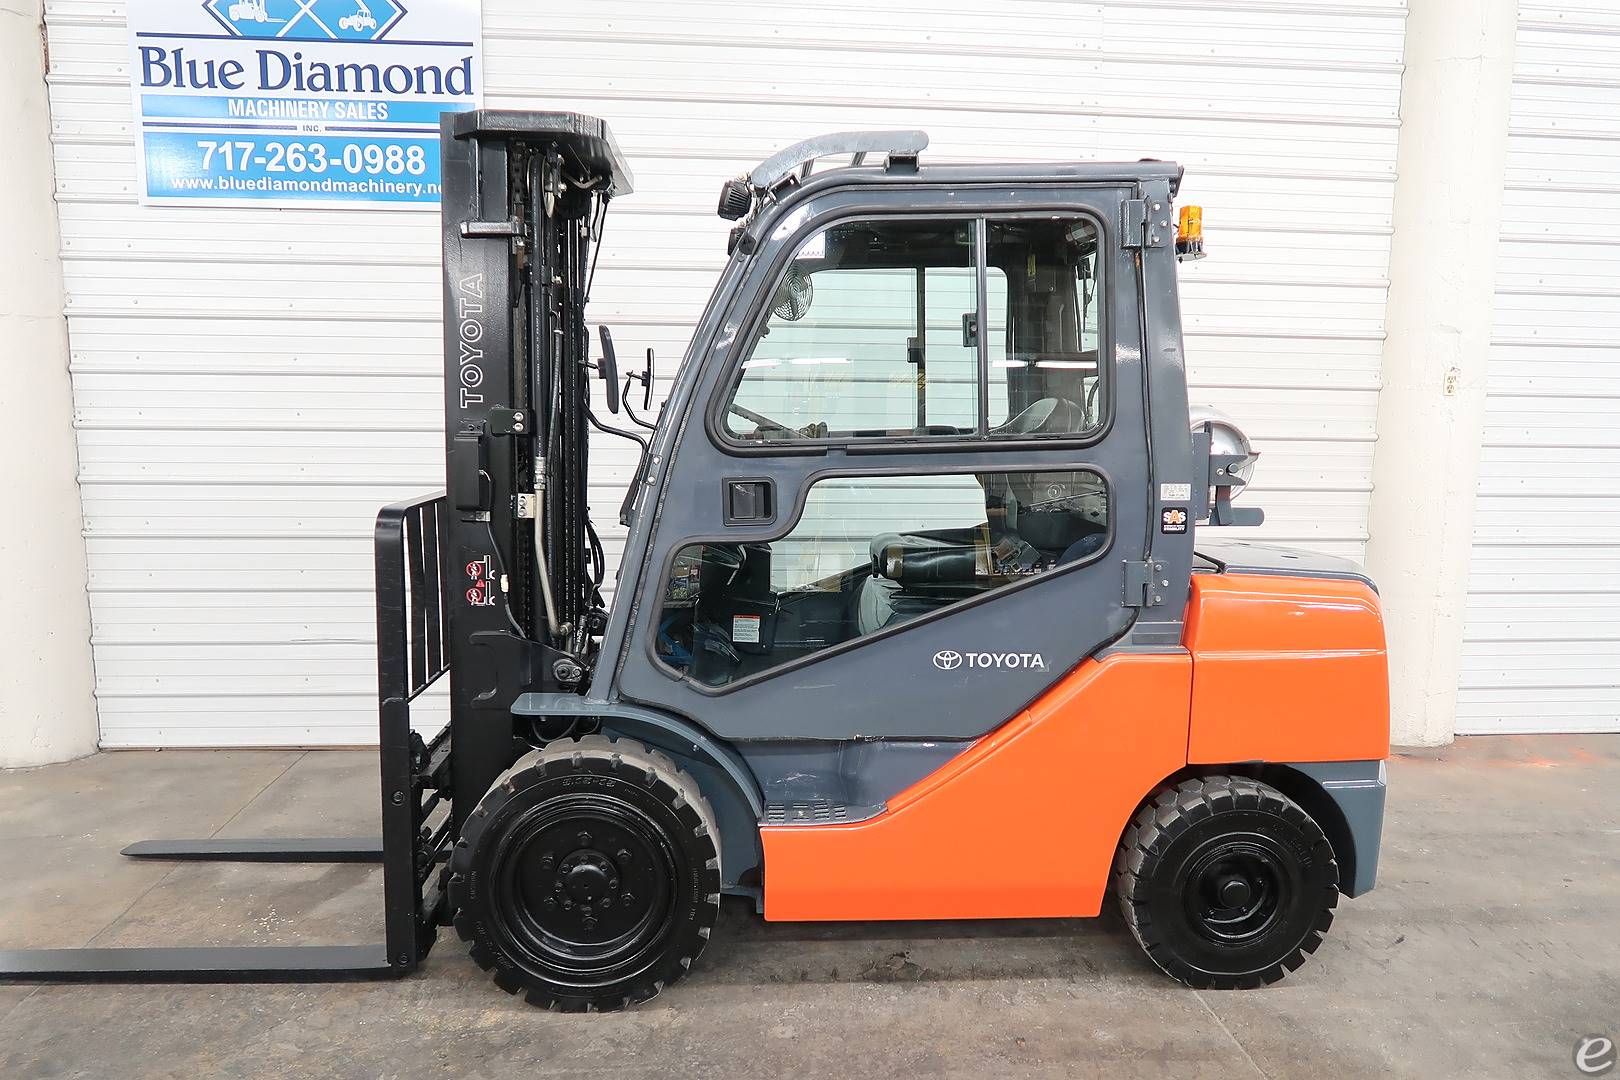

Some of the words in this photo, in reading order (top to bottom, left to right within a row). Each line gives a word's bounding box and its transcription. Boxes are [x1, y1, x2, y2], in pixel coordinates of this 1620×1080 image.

[138, 46, 245, 90] Blue
[255, 49, 474, 96] Diamond
[228, 98, 330, 120] MACHINERY
[334, 102, 389, 121] SALES
[302, 124, 322, 133] INC.
[197, 140, 426, 175] 717-263-0988
[459, 273, 484, 409] TOYOTA
[1163, 509, 1186, 522] SAS
[965, 652, 1045, 668] TOYOTA
